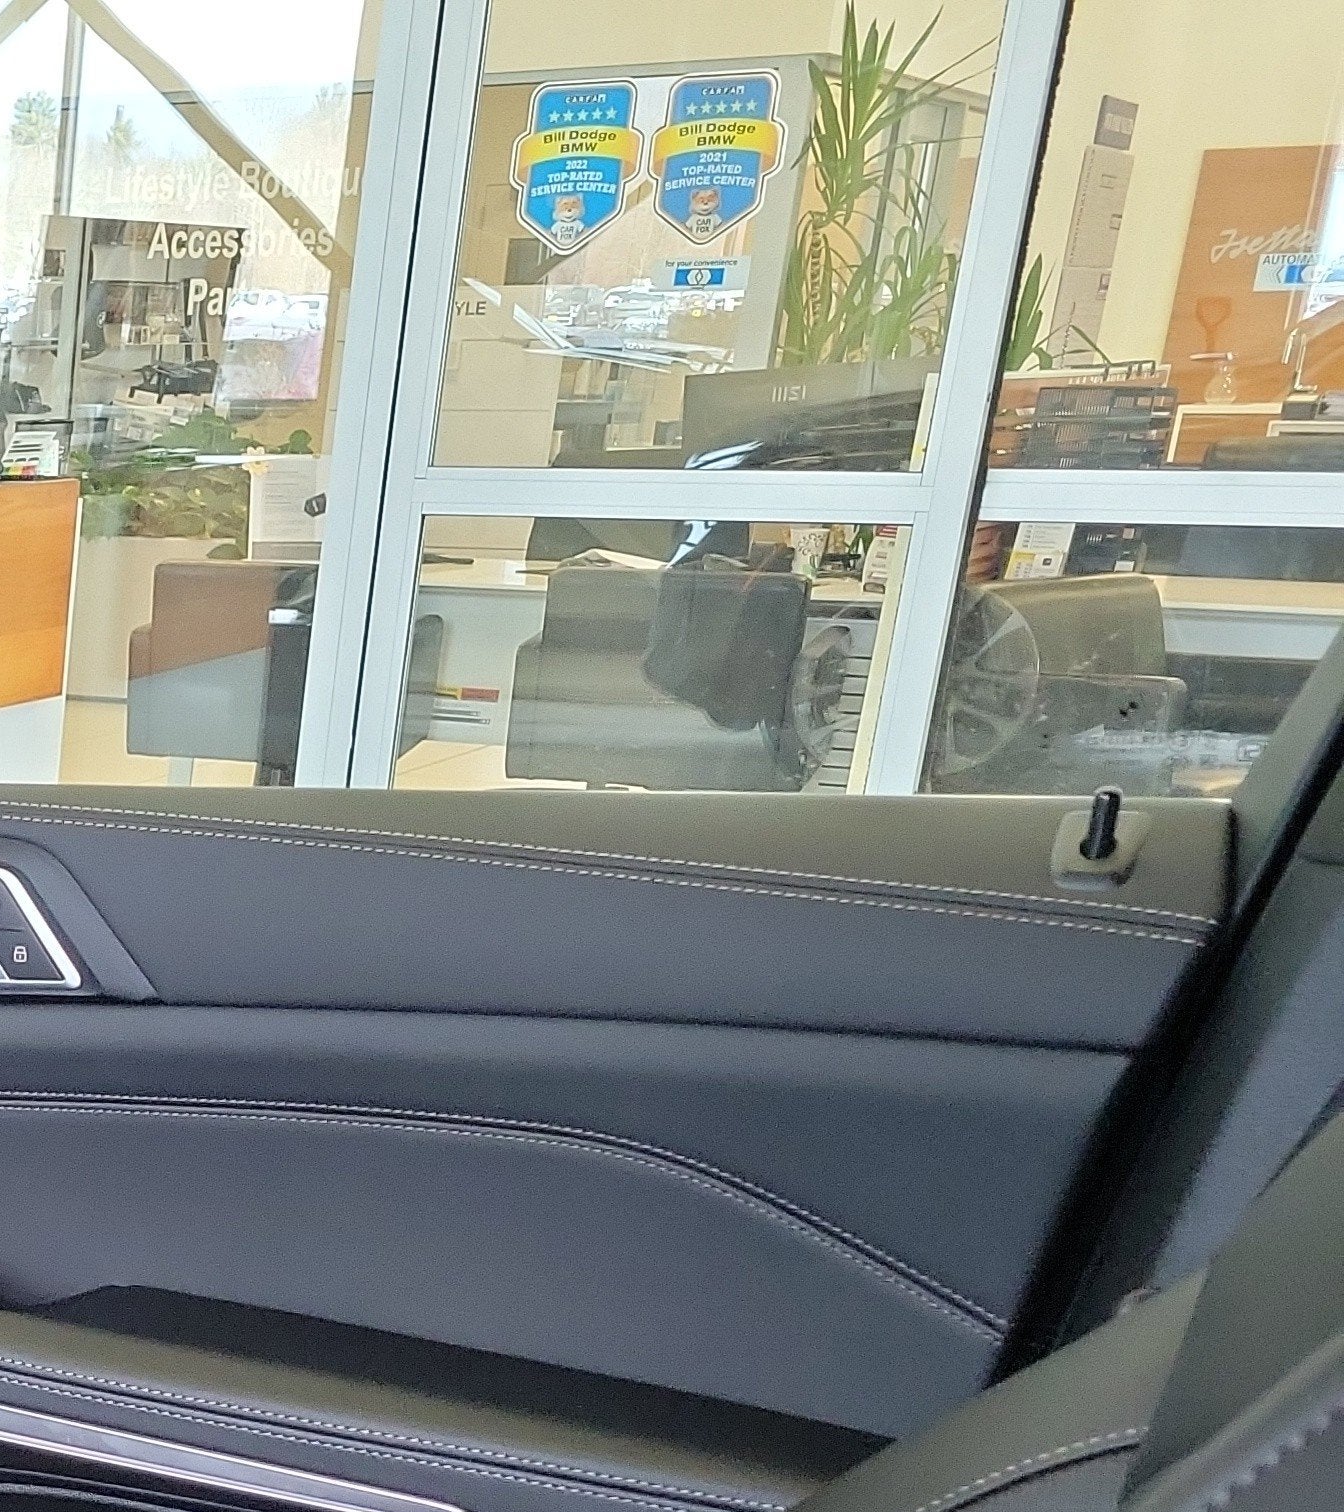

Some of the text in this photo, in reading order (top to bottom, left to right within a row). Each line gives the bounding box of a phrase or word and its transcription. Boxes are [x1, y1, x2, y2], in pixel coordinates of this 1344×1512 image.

[679, 122, 756, 137] Bill Dodge
[543, 130, 617, 144] Bill Dodge
[696, 135, 736, 146] BMW
[560, 143, 598, 153] BMW
[699, 152, 727, 163] 2021
[565, 160, 588, 170] 2022
[682, 164, 742, 176] TOP-RATED
[547, 172, 603, 183] TOP-RATED
[665, 176, 755, 191] SERVICE CENTER
[530, 183, 617, 197] SERVICE CENTER
[696, 218, 712, 226] CAR
[695, 226, 711, 234] FOX
[147, 218, 334, 260] Accessories
[664, 259, 738, 268] for your convenience
